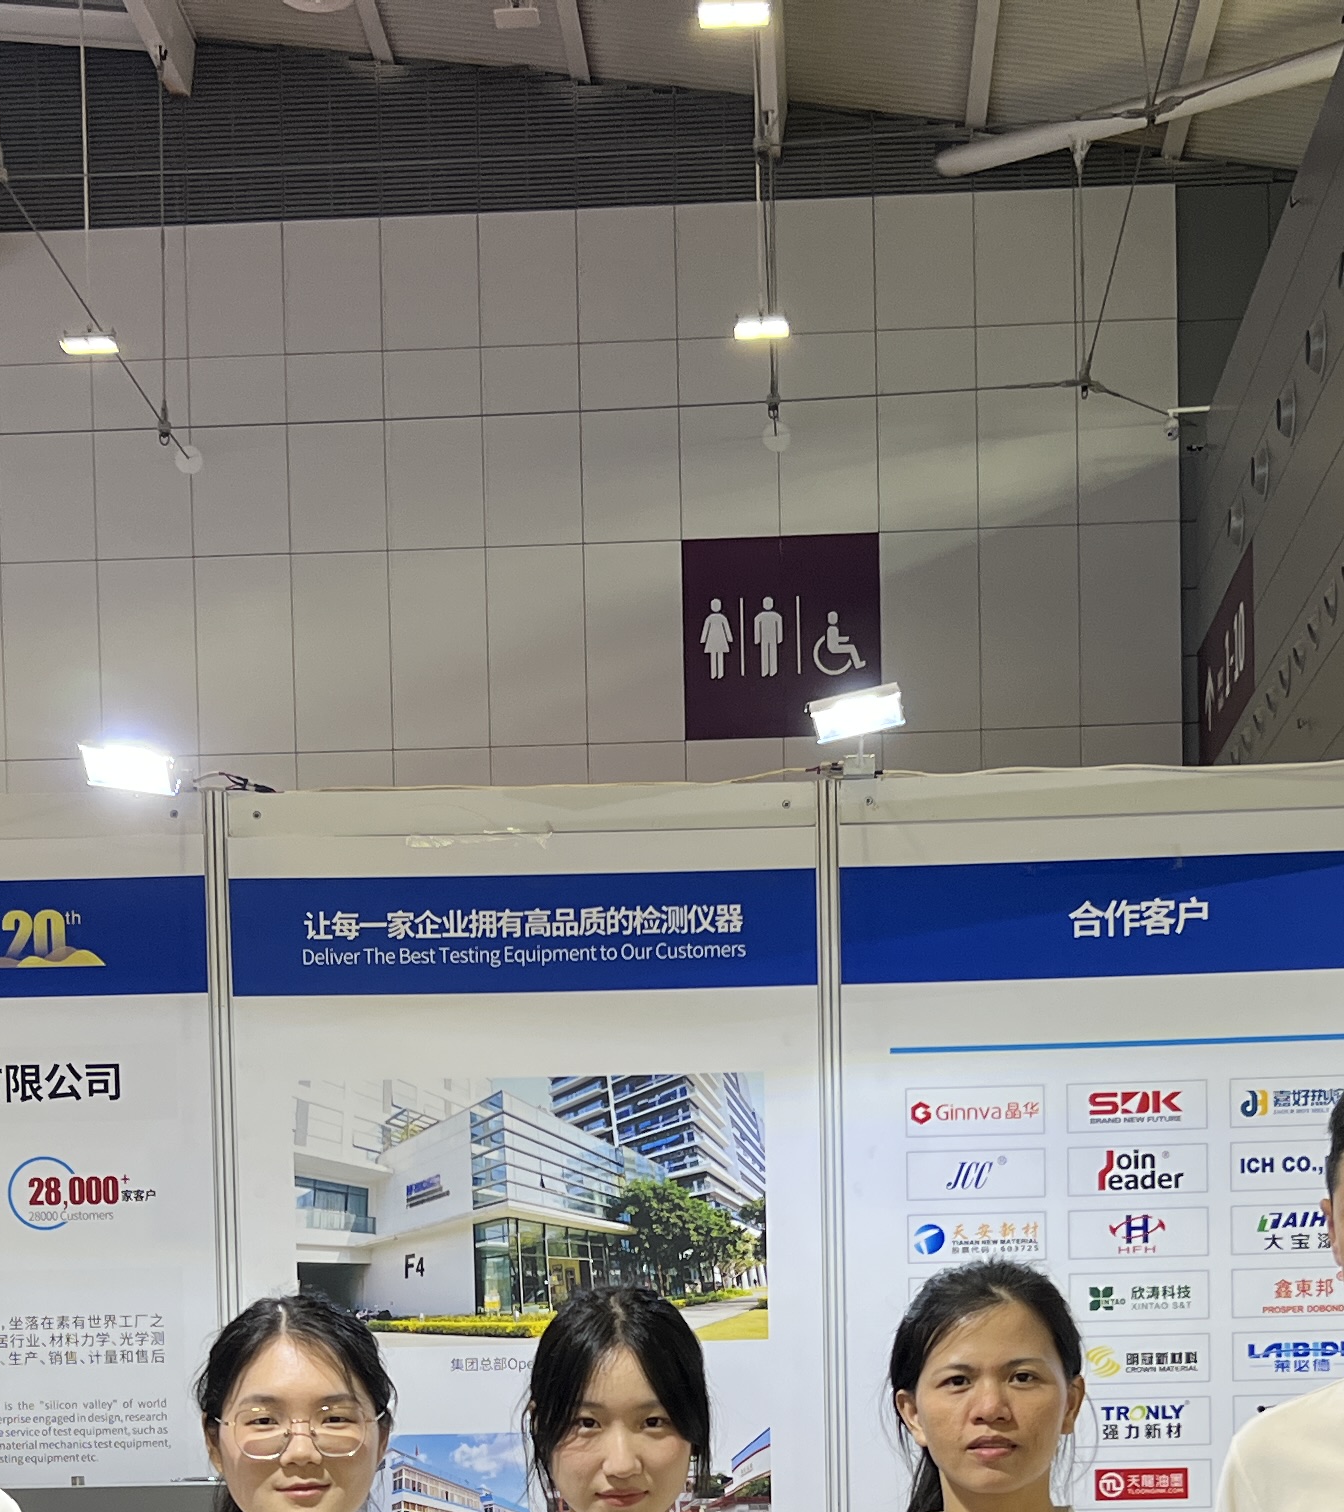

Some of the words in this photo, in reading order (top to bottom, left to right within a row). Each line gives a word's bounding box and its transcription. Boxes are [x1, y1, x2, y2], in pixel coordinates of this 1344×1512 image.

[303, 903, 744, 941] 让每一家企业拥有高品质的检测仪器
[1068, 896, 1210, 940] 合作客户
[302, 947, 358, 967] Deliver
[363, 947, 396, 966] The
[399, 946, 436, 965] Best
[440, 944, 502, 968] Testing
[504, 943, 598, 967] Equipment
[599, 944, 618, 961] to
[620, 942, 652, 961] Our
[655, 940, 747, 960] Customers
[936, 1103, 1002, 1122] Ginnva
[1006, 1101, 1040, 1120] 晶华
[1089, 1116, 1122, 1125] BRAND
[1124, 1116, 1145, 1124] NEW
[1147, 1115, 1182, 1123] FUTURE
[1240, 1158, 1275, 1174] ICH
[945, 1160, 993, 1191] JCC
[121, 1188, 157, 1203] 家客户
[28, 1211, 59, 1222] 28000
[60, 1209, 115, 1222] Customers
[952, 1221, 1040, 1240] 天安新材
[1117, 1245, 1157, 1255] HFH
[404, 1253, 426, 1280] F4
[1130, 1284, 1192, 1300] 欣涛科技
[1274, 1278, 1334, 1299] 鑫東邦
[1131, 1301, 1169, 1311] XINTAO
[1172, 1300, 1192, 1310] S&T
[1262, 1304, 1305, 1314] PROSPER
[1306, 1303, 1344, 1313] DOBOND
[4, 1401, 13, 1411] is
[17, 1400, 35, 1411] the
[122, 1399, 133, 1409] of
[137, 1398, 167, 1409] world
[1101, 1404, 1184, 1421] TRONLY
[32, 1413, 76, 1427] engaged
[76, 1413, 87, 1423] in
[124, 1411, 168, 1422] research
[5, 1427, 40, 1438] service
[41, 1426, 53, 1437] of
[53, 1426, 72, 1437] test
[132, 1424, 155, 1435] such
[156, 1426, 168, 1435] as
[1102, 1423, 1183, 1441] 强力新材
[39, 1438, 93, 1449] mechanics
[93, 1438, 112, 1448] test
[24, 1452, 80, 1466] equipment
